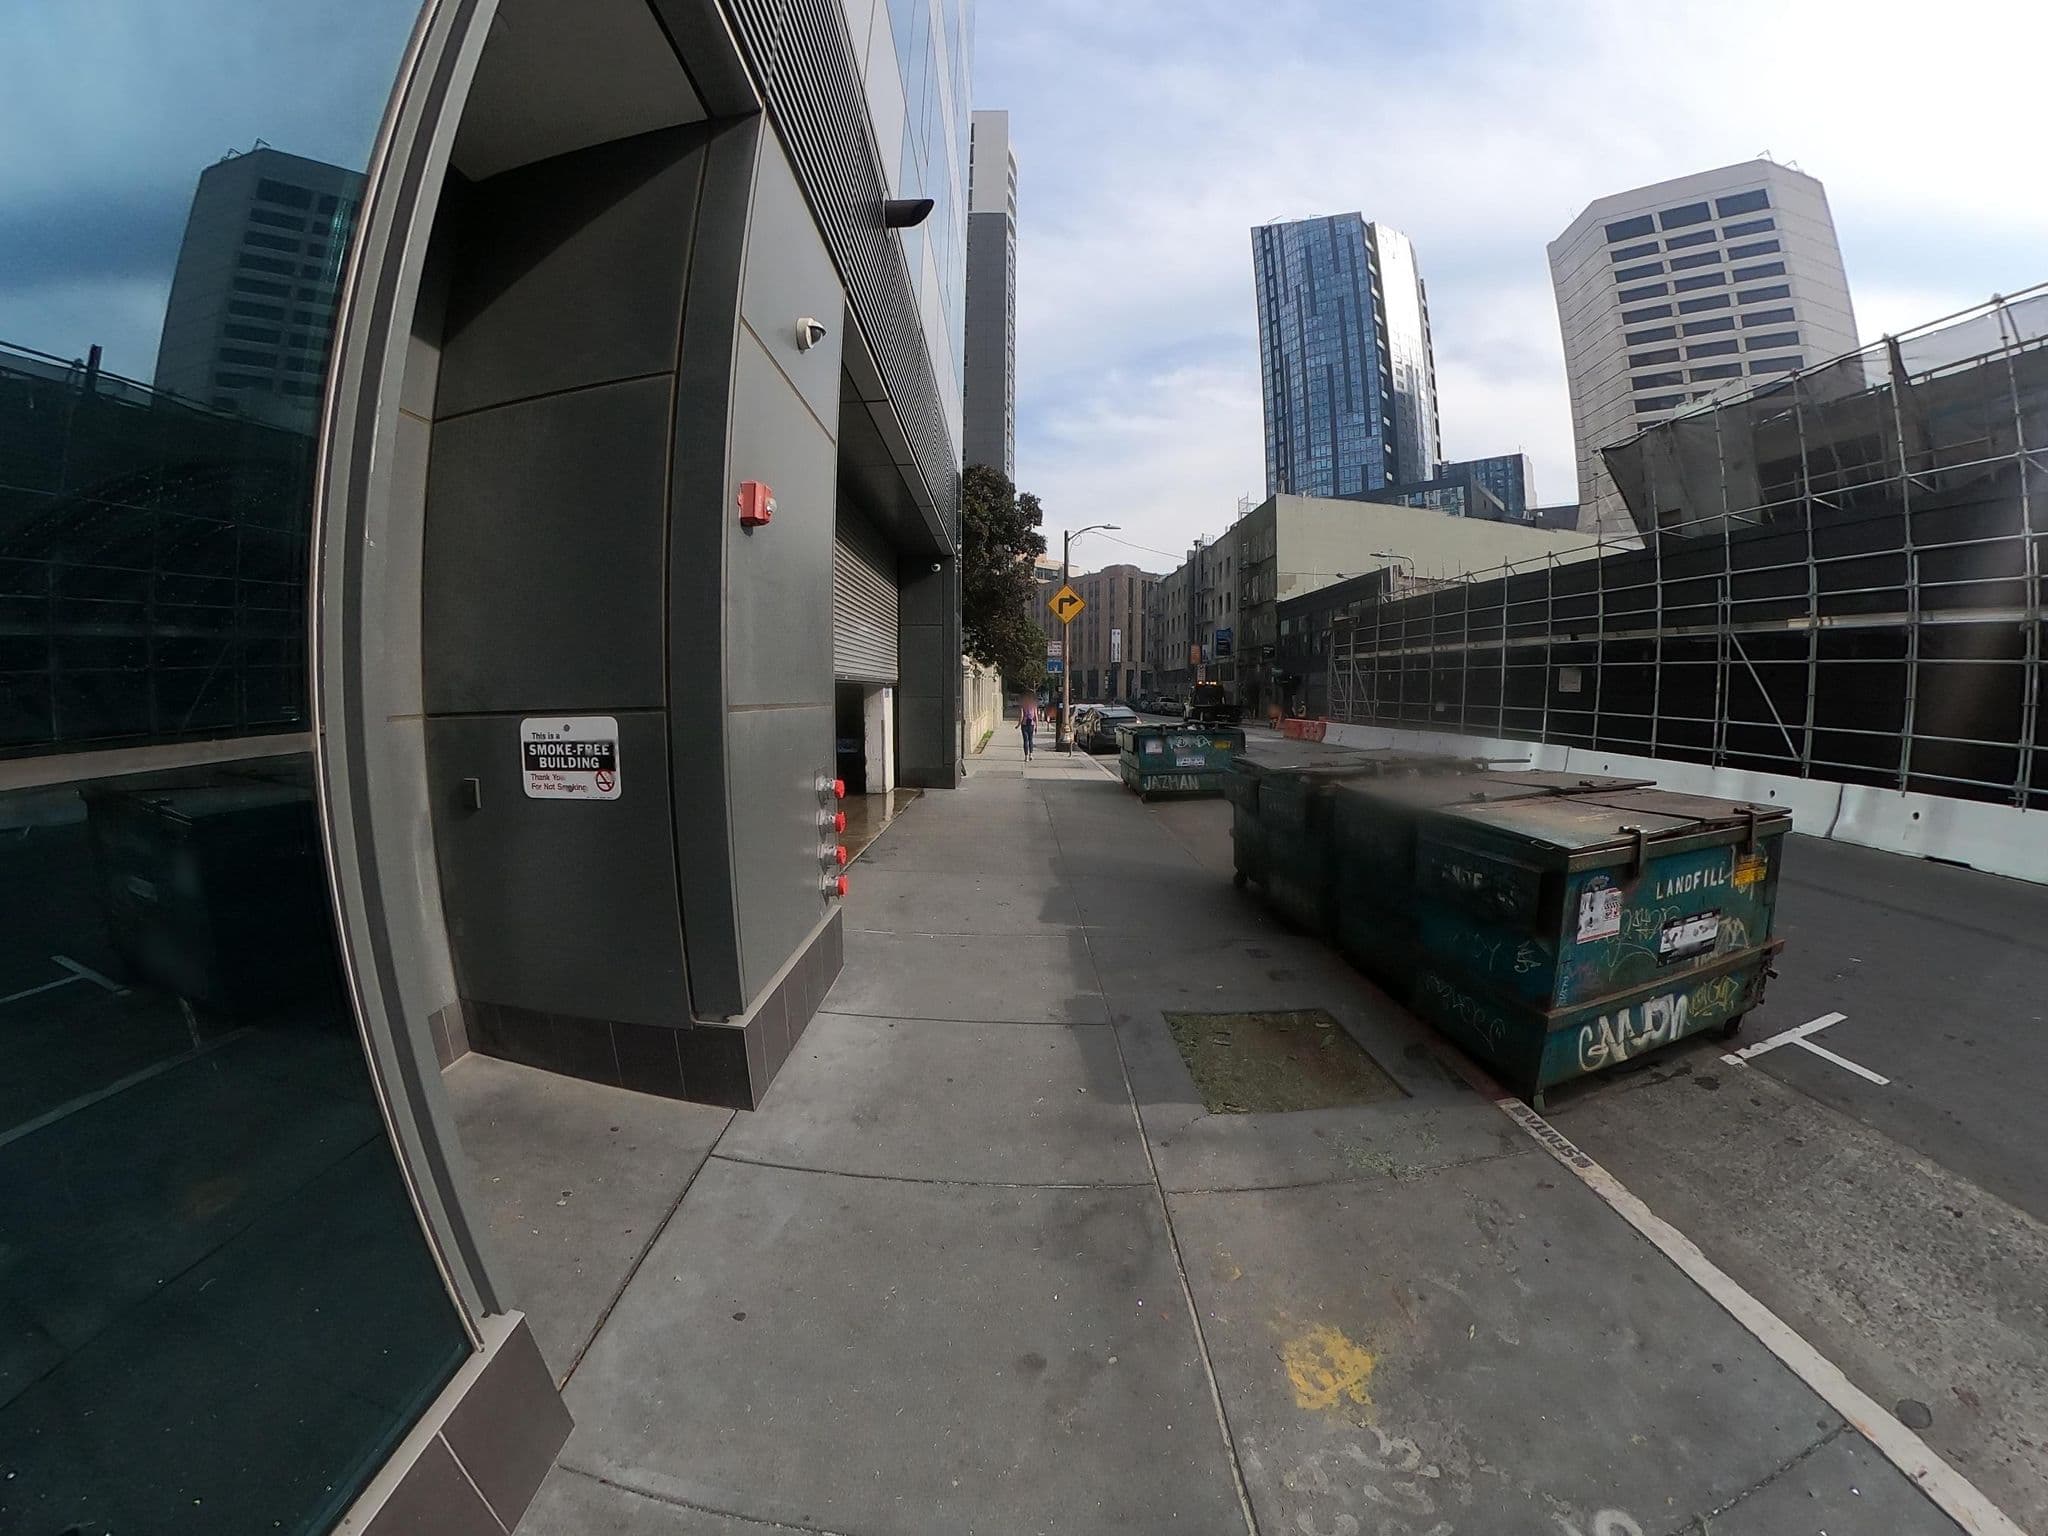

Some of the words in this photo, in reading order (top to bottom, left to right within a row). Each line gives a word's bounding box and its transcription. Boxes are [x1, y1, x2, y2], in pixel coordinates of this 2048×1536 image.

[531, 732, 546, 740] This
[529, 744, 610, 756] SMOKE-FREE
[539, 757, 600, 769] BUILDING
[531, 773, 550, 781] Thank
[1655, 867, 1726, 900] LANDFILL
